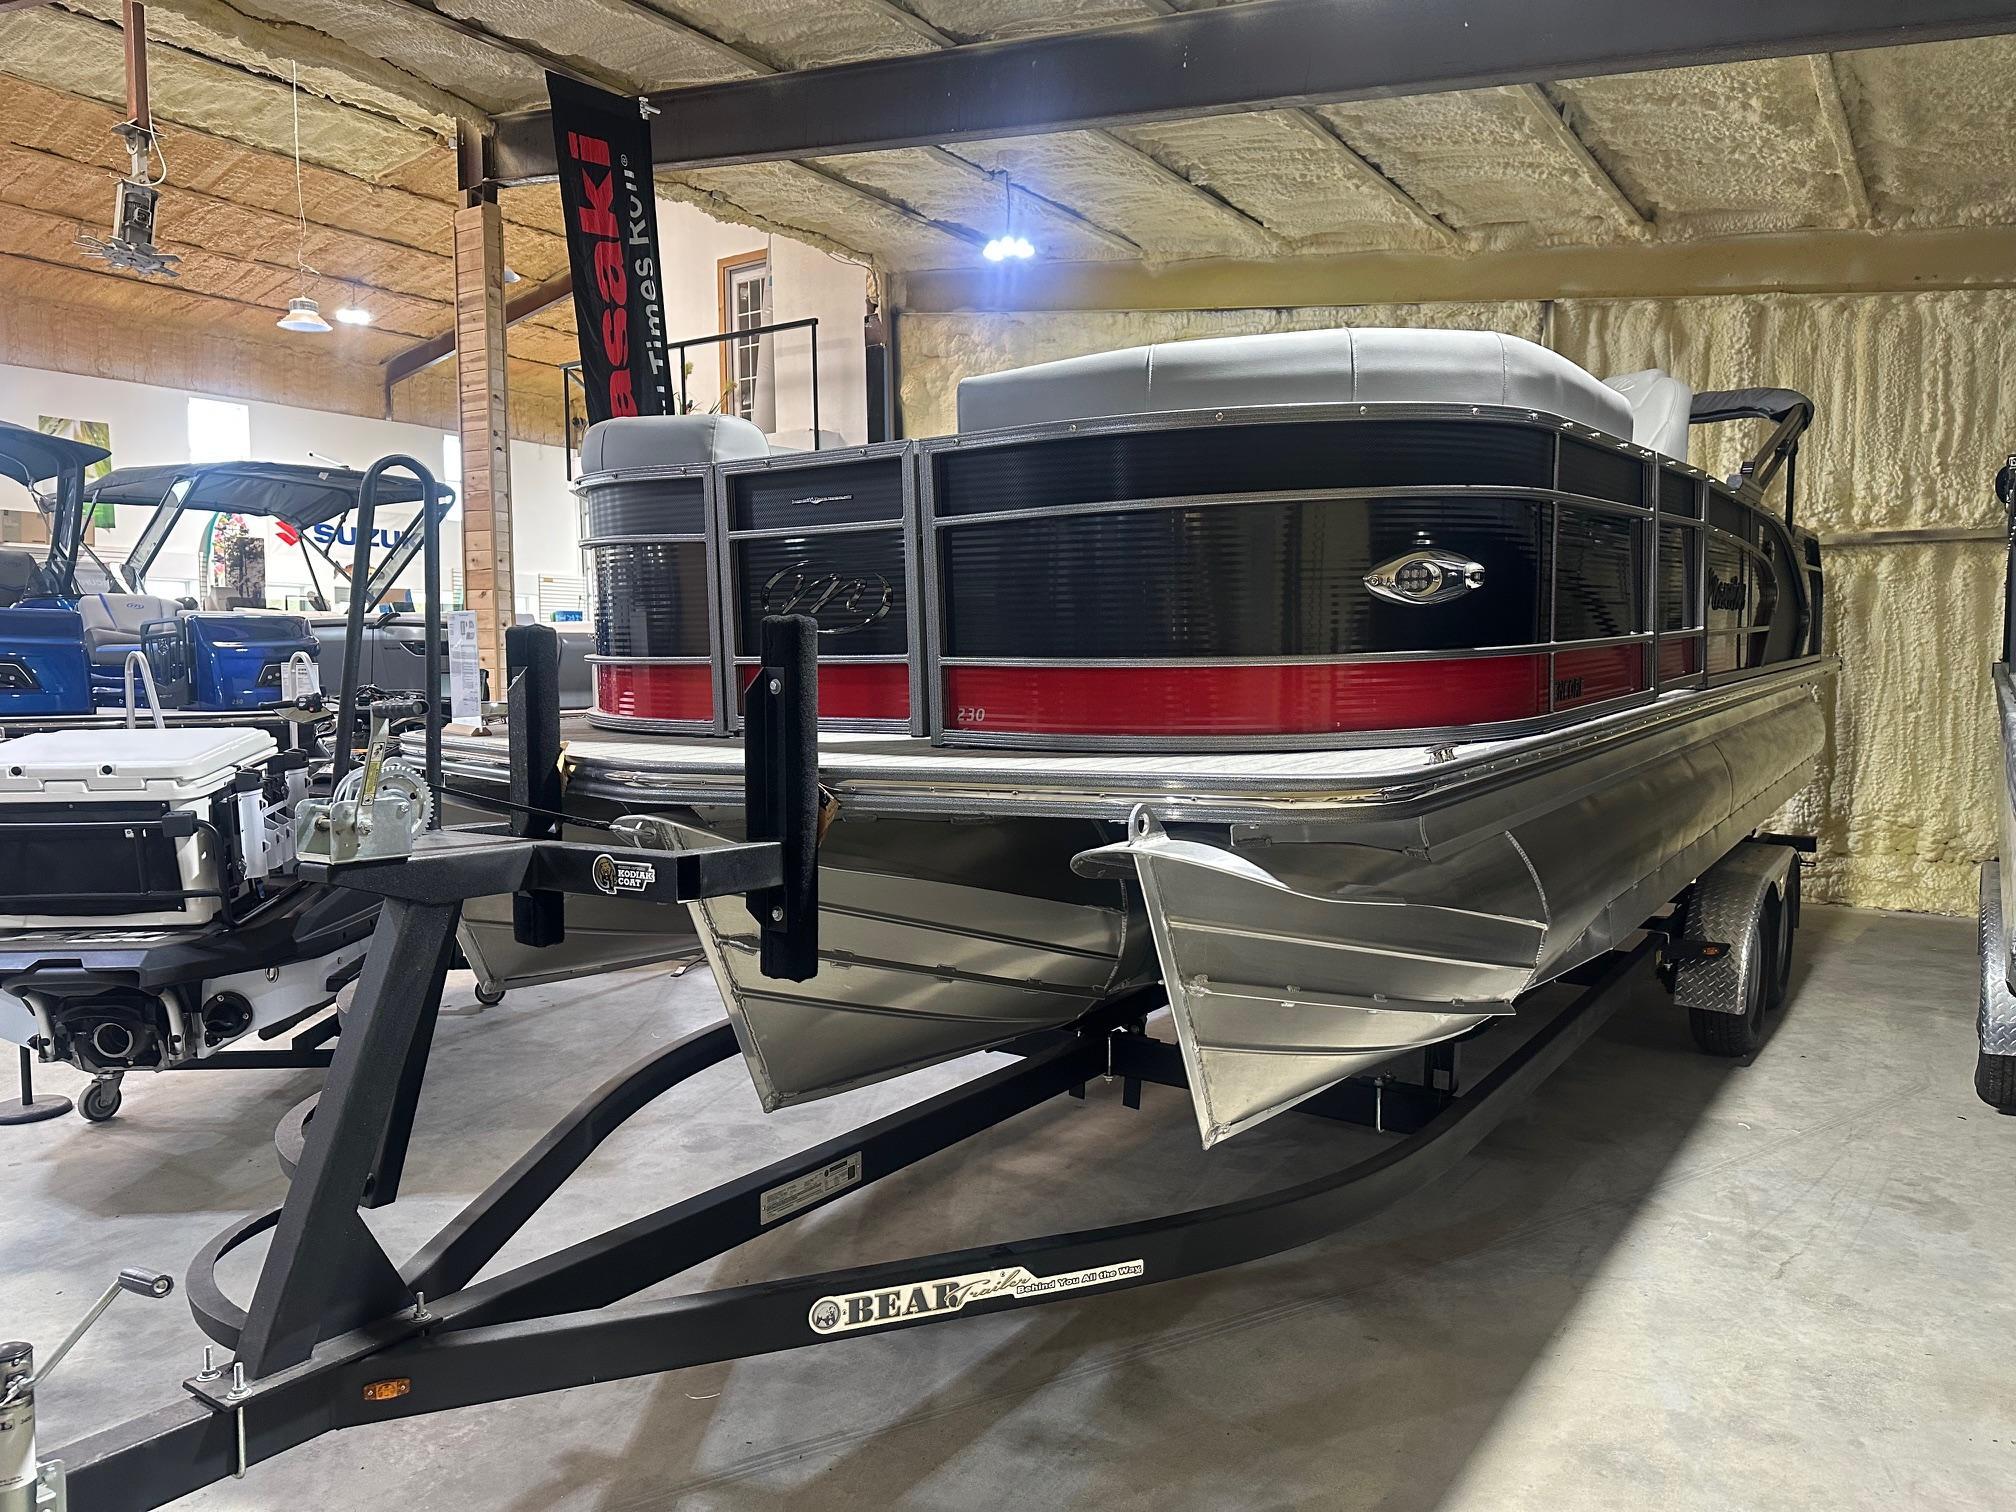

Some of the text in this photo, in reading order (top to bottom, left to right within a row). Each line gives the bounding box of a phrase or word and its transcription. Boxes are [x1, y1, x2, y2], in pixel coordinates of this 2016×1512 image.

[568, 131, 638, 417] asaki
[634, 257, 664, 375] Times
[957, 707, 986, 721] 230
[617, 869, 653, 880] KODIAK
[617, 877, 642, 887] COAT
[1016, 1280, 1056, 1294] Behind
[1058, 1276, 1081, 1287] You
[1081, 1273, 1097, 1283] All
[1098, 1269, 1118, 1280] the
[844, 1281, 960, 1325] BEAR
